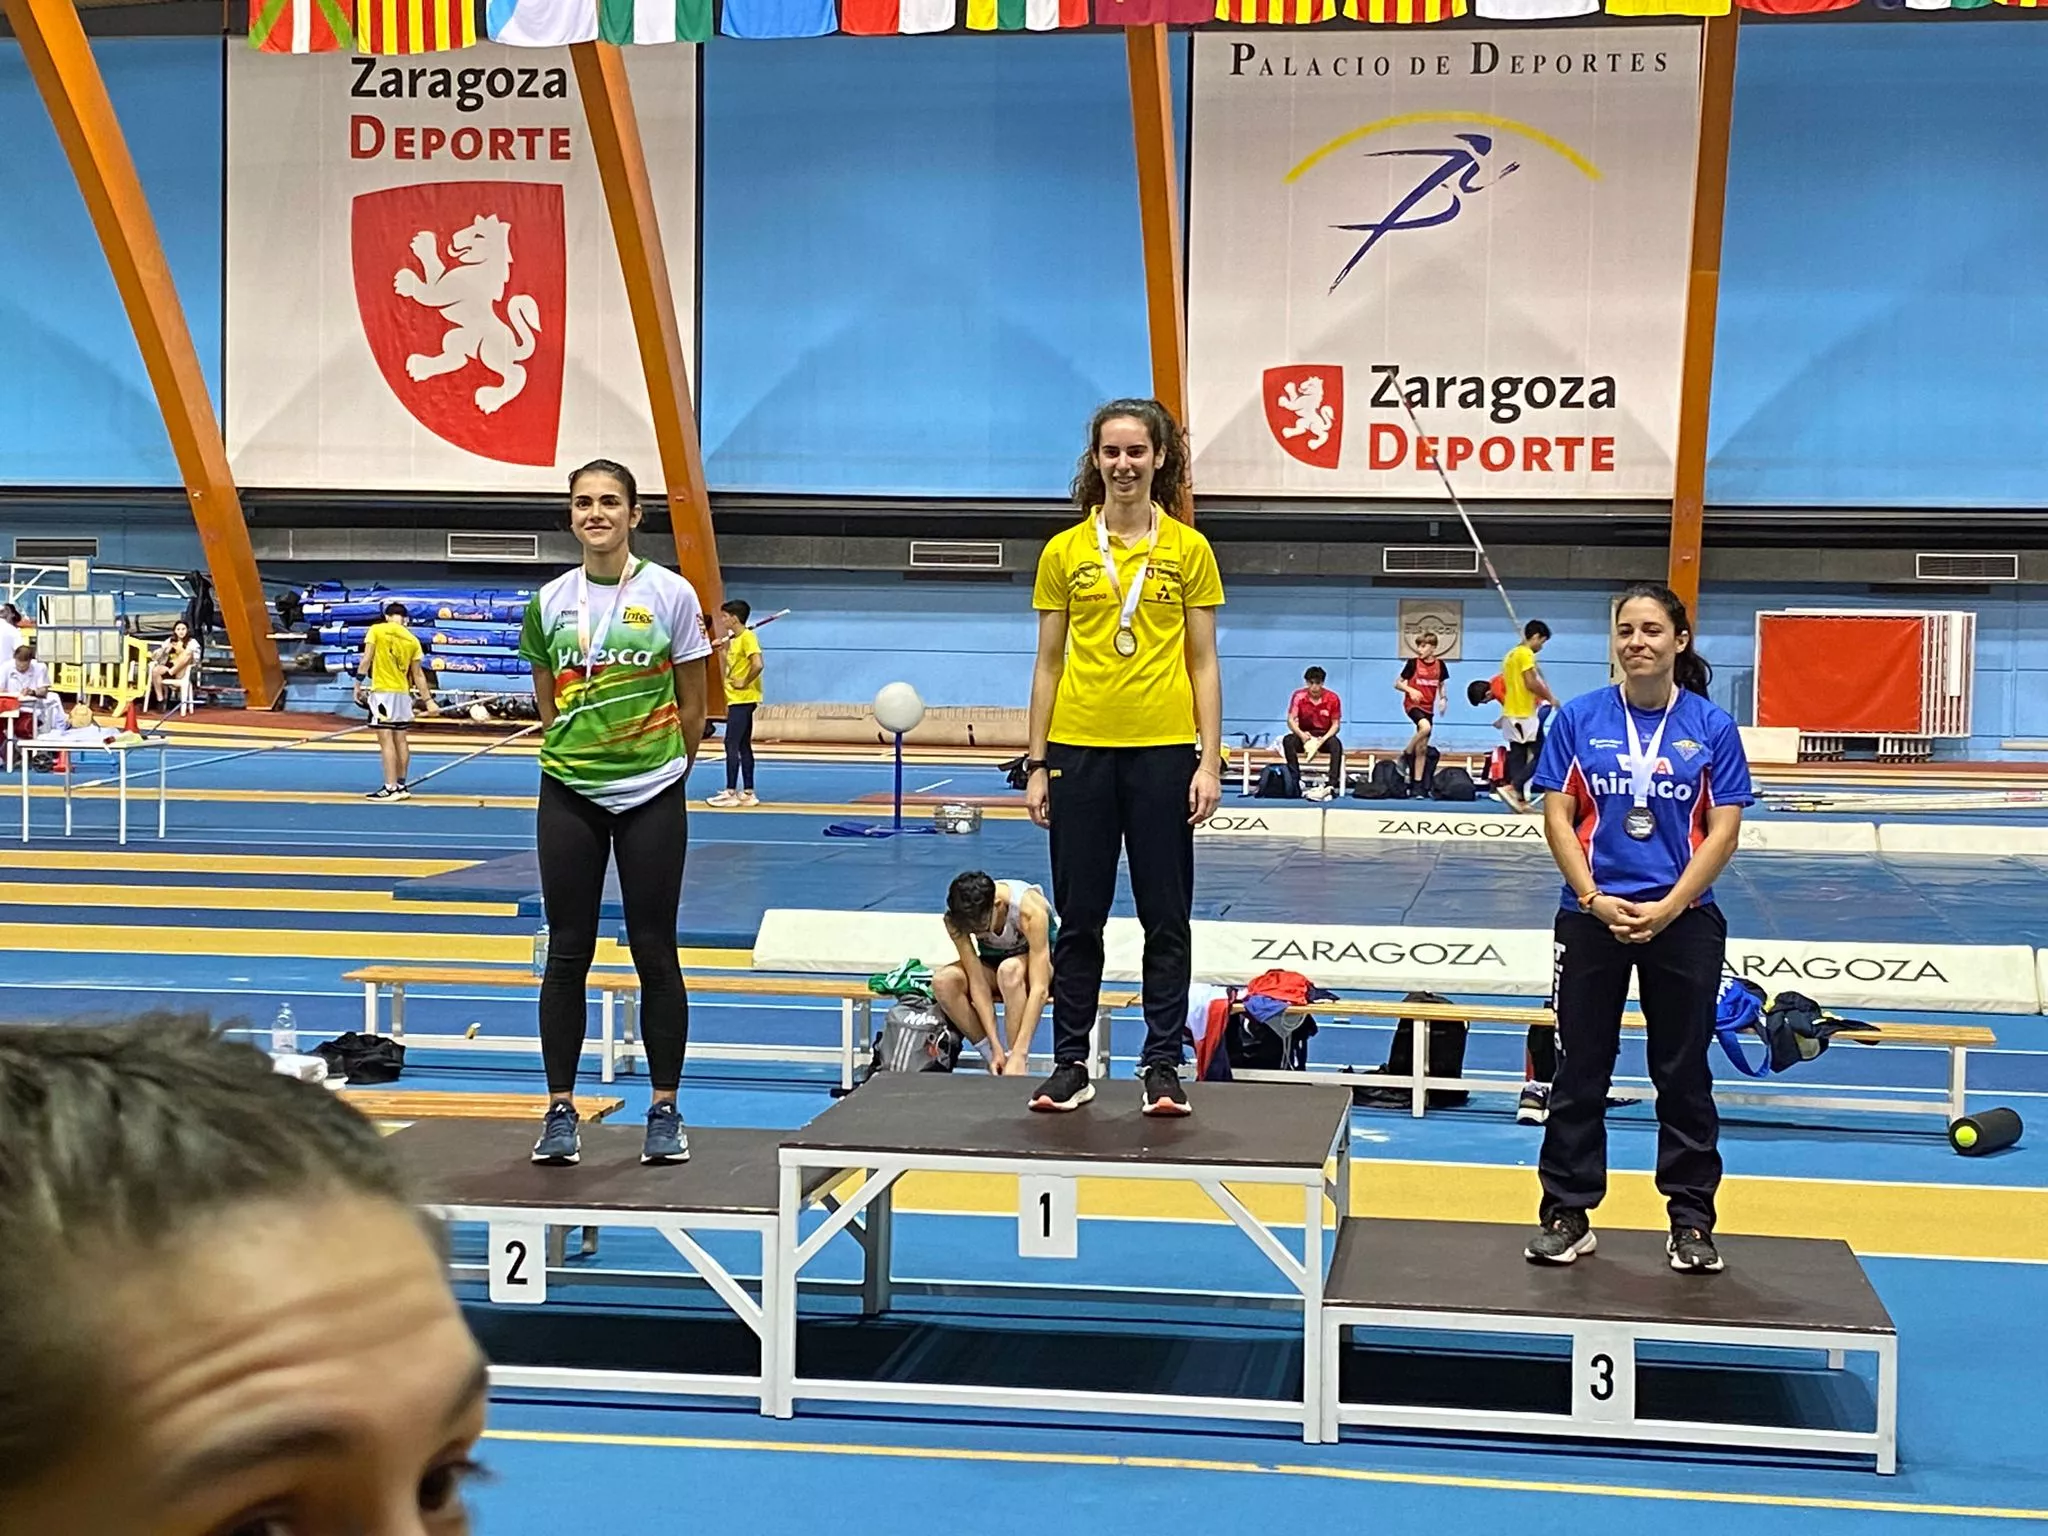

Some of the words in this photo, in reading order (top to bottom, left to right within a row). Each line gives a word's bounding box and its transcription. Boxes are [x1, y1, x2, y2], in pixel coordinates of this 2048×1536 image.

[1230, 42, 1390, 77] PALACIO
[1410, 55, 1450, 75] DE
[1470, 41, 1668, 75] DEPORTES
[351, 57, 567, 112] Zaragoza
[350, 115, 571, 161] DEPORTE
[1370, 365, 1616, 423] Zaragoza
[1369, 423, 1616, 472] DEPORTE
[1379, 820, 1542, 838] ZARAGOZA
[1252, 939, 1506, 966] ZARAGOZA
[1722, 955, 1949, 982] ARAGOZA
[1039, 1192, 1051, 1238] 1
[505, 1240, 528, 1285] 2
[1590, 1353, 1614, 1401] 3
